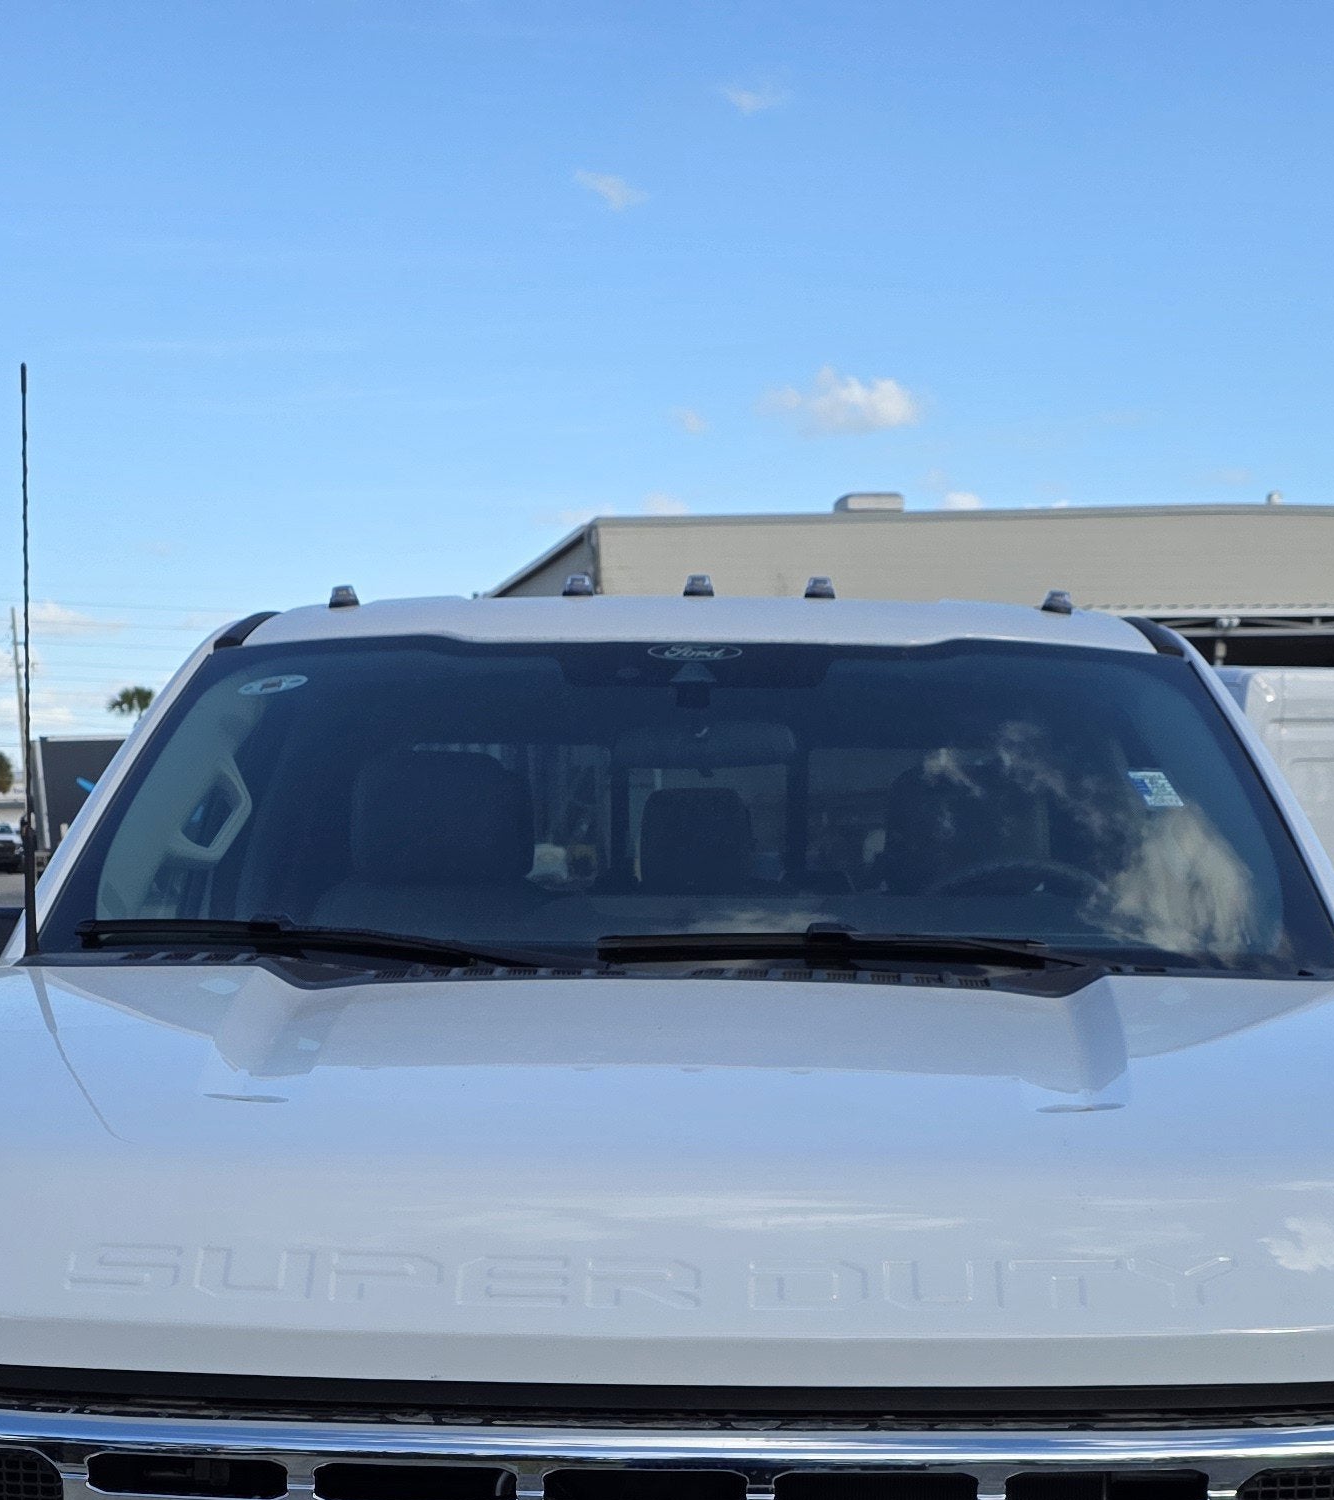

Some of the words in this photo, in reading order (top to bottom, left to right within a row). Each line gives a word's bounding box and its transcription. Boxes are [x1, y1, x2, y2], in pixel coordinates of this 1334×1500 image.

[664, 644, 726, 658] Ford
[63, 1243, 703, 1310] SUPER
[746, 1256, 1239, 1310] DUTY
